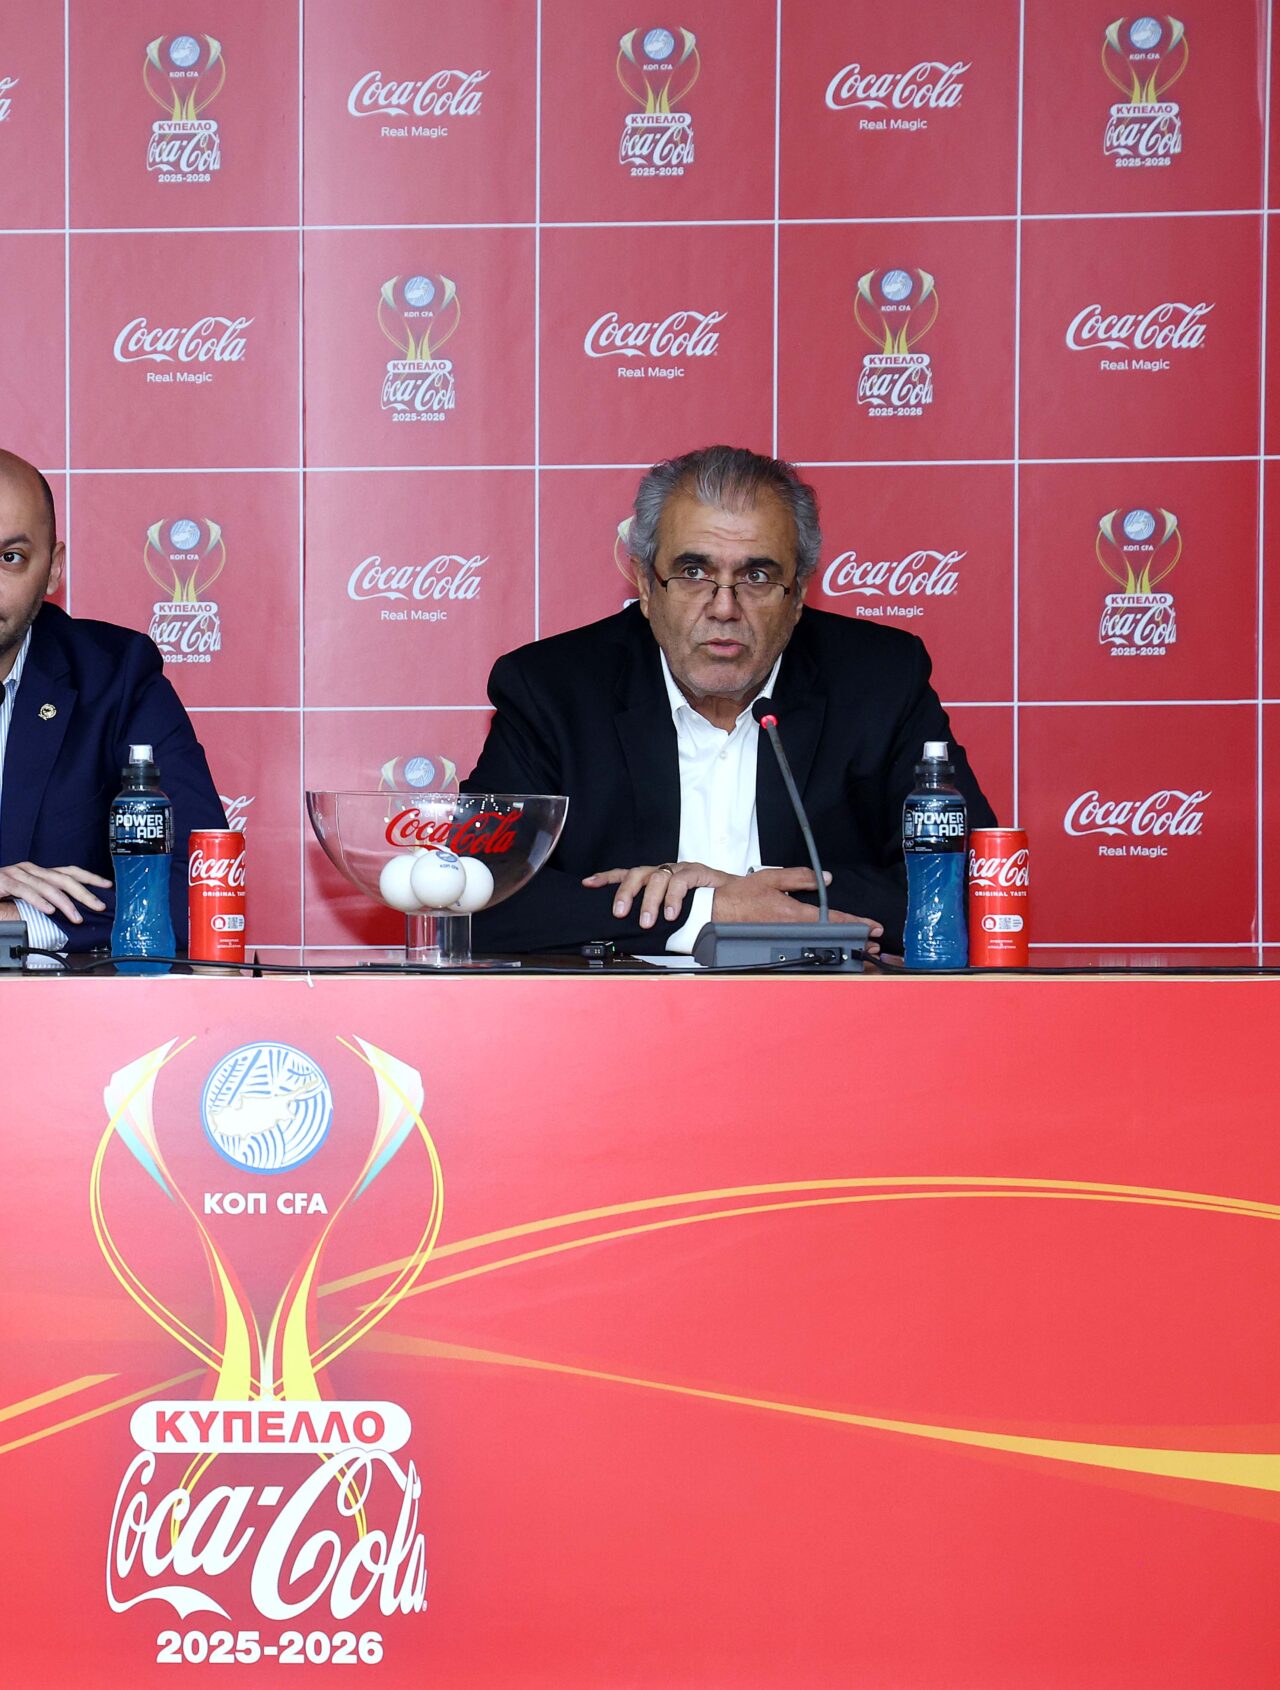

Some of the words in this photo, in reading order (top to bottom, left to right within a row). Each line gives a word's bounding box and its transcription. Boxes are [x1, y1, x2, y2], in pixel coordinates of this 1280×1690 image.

[825, 61, 971, 110] Coca-Cola
[347, 70, 490, 117] Coca-Cola
[859, 118, 886, 129] Real
[890, 118, 927, 131] Magic
[381, 126, 408, 136] Real
[411, 126, 448, 138] Magic
[1115, 157, 1171, 167] 2025-2026
[630, 167, 684, 176] 2025-2026
[158, 174, 211, 183] 2025-2026
[1065, 303, 1215, 351] Coca-Cola
[113, 317, 255, 363] Coca-Cola
[584, 311, 727, 358] Coca-Cola
[1100, 359, 1128, 370] Real
[1132, 359, 1170, 372] Magic
[147, 371, 173, 382] Real
[177, 371, 213, 384] Magic
[617, 366, 644, 377] Real
[647, 366, 684, 379] Magic
[392, 413, 445, 422] 2025-2026
[868, 408, 923, 416] 2025-2026
[347, 555, 489, 601] Coca-Cola
[822, 550, 967, 596] Coca-Cola
[381, 609, 407, 620] Real
[411, 609, 447, 622] Magic
[856, 605, 883, 616] Real
[887, 605, 924, 618] Magic
[1111, 647, 1166, 656] 2025-2026
[914, 812, 963, 824] POWER
[1064, 790, 1212, 836] Coca-Cola
[116, 814, 163, 826] POWER
[137, 826, 164, 838] ADE
[939, 824, 964, 836] ADE
[1098, 845, 1126, 856] Real
[1130, 845, 1168, 858] Magic
[276, 1193, 328, 1215] CFA
[156, 1630, 383, 1664] 2025-2026
